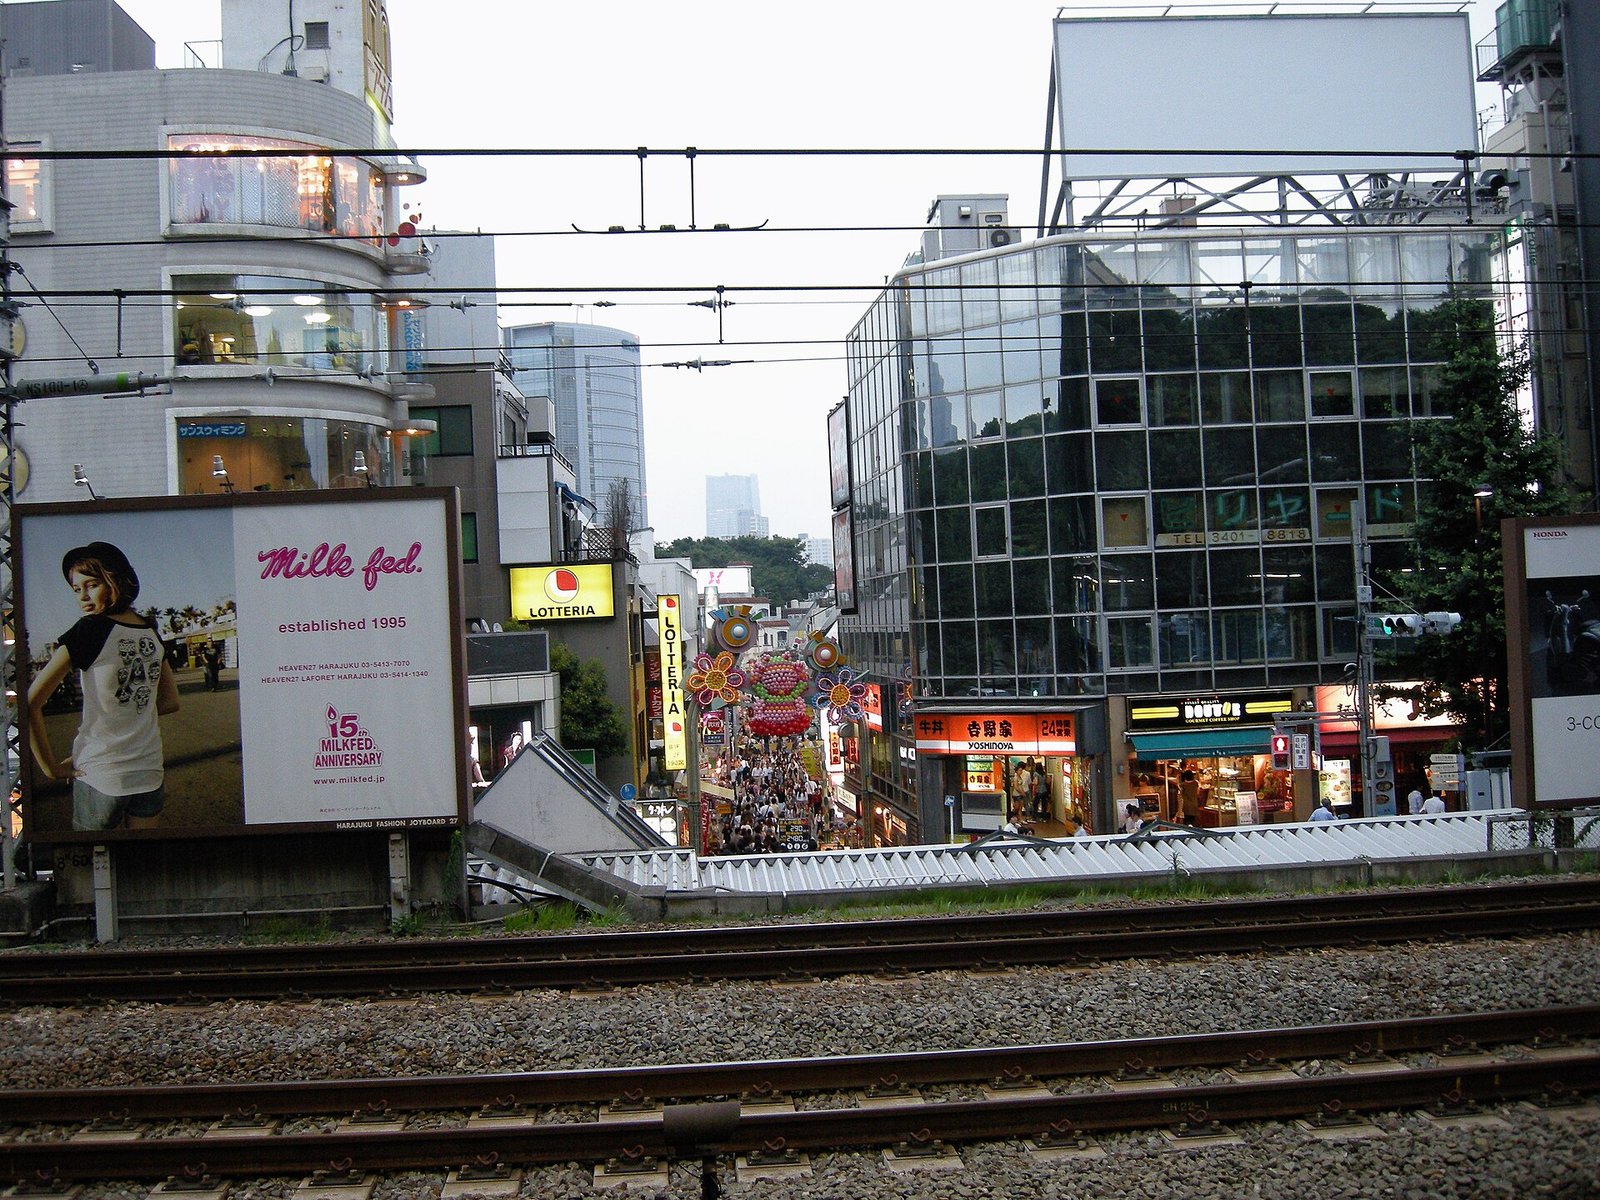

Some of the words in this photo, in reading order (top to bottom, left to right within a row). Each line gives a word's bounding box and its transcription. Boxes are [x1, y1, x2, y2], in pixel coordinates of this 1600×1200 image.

[1173, 533, 1204, 544] TEL
[1266, 529, 1307, 541] 8818
[257, 542, 355, 580] Milk
[361, 541, 423, 592] fed.
[529, 605, 596, 618] LOTTERIA
[278, 618, 366, 633] established
[371, 616, 407, 629] 1995
[278, 664, 317, 672] HEAVEN27
[318, 662, 360, 670] HARAJUKU
[664, 616, 680, 715] LOTTERIA
[261, 676, 300, 684] HEAVEN27
[301, 674, 336, 682] LAFORET
[337, 672, 378, 680] HARAJUKU
[919, 719, 944, 735] 牛丼
[967, 719, 1013, 738] 吉野家
[321, 738, 377, 752] MILKFED.
[968, 742, 1014, 750] YOSHINOYA
[315, 752, 382, 768] ANNIVERSARY
[313, 775, 385, 786] www.milkfed.jp
[336, 821, 373, 830] HARAJUKU
[376, 819, 406, 828] FASHION
[409, 818, 446, 827] JOYBOARD
[449, 817, 458, 825] 27
